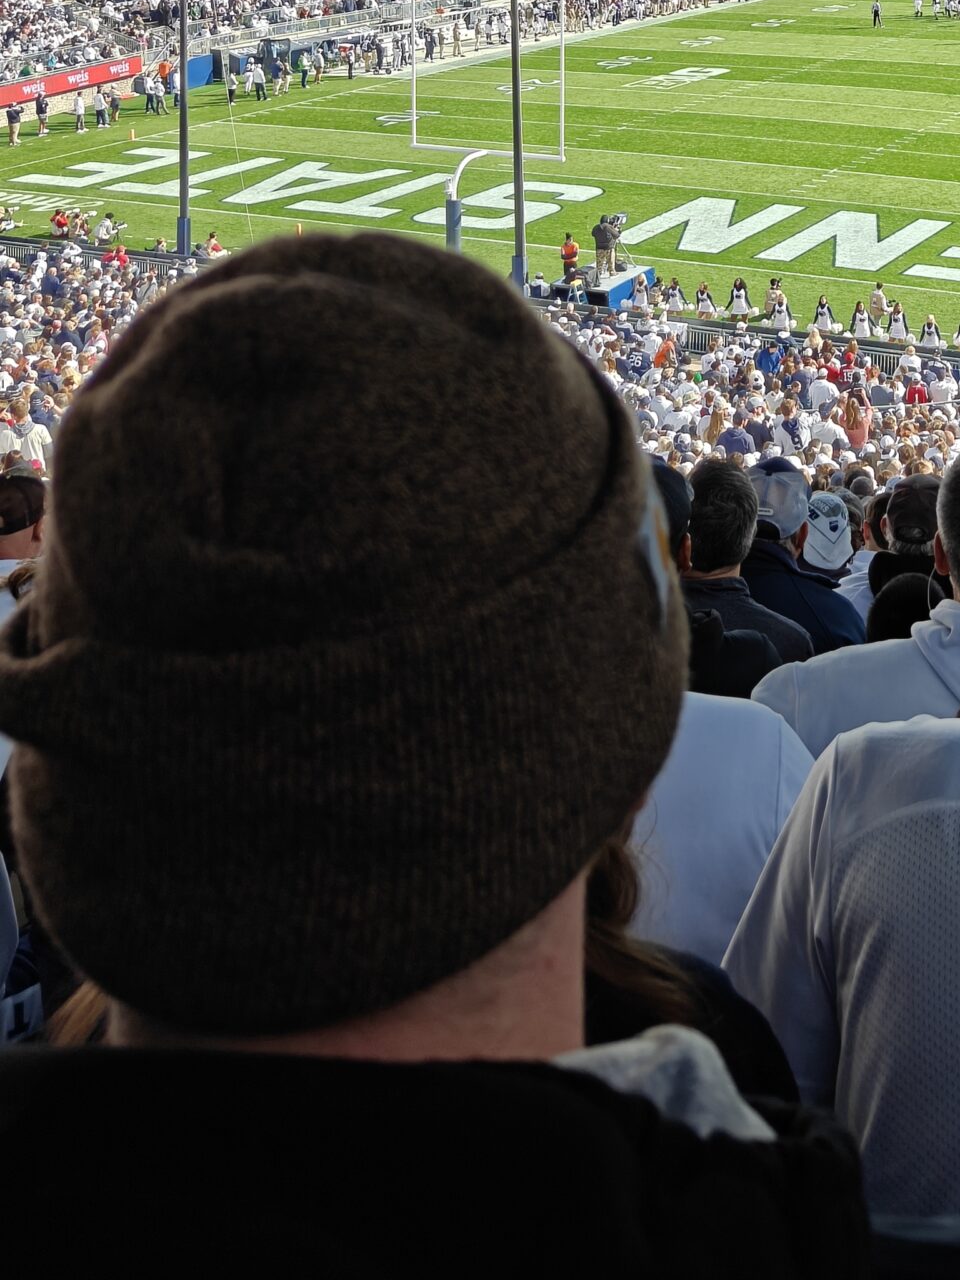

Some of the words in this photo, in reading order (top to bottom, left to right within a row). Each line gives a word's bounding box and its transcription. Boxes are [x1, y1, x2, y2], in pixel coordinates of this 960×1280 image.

[110, 62, 130, 75] weis
[68, 70, 88, 84] weis
[22, 80, 46, 95] weis
[8, 147, 606, 230] STATE
[630, 355, 642, 367] 26
